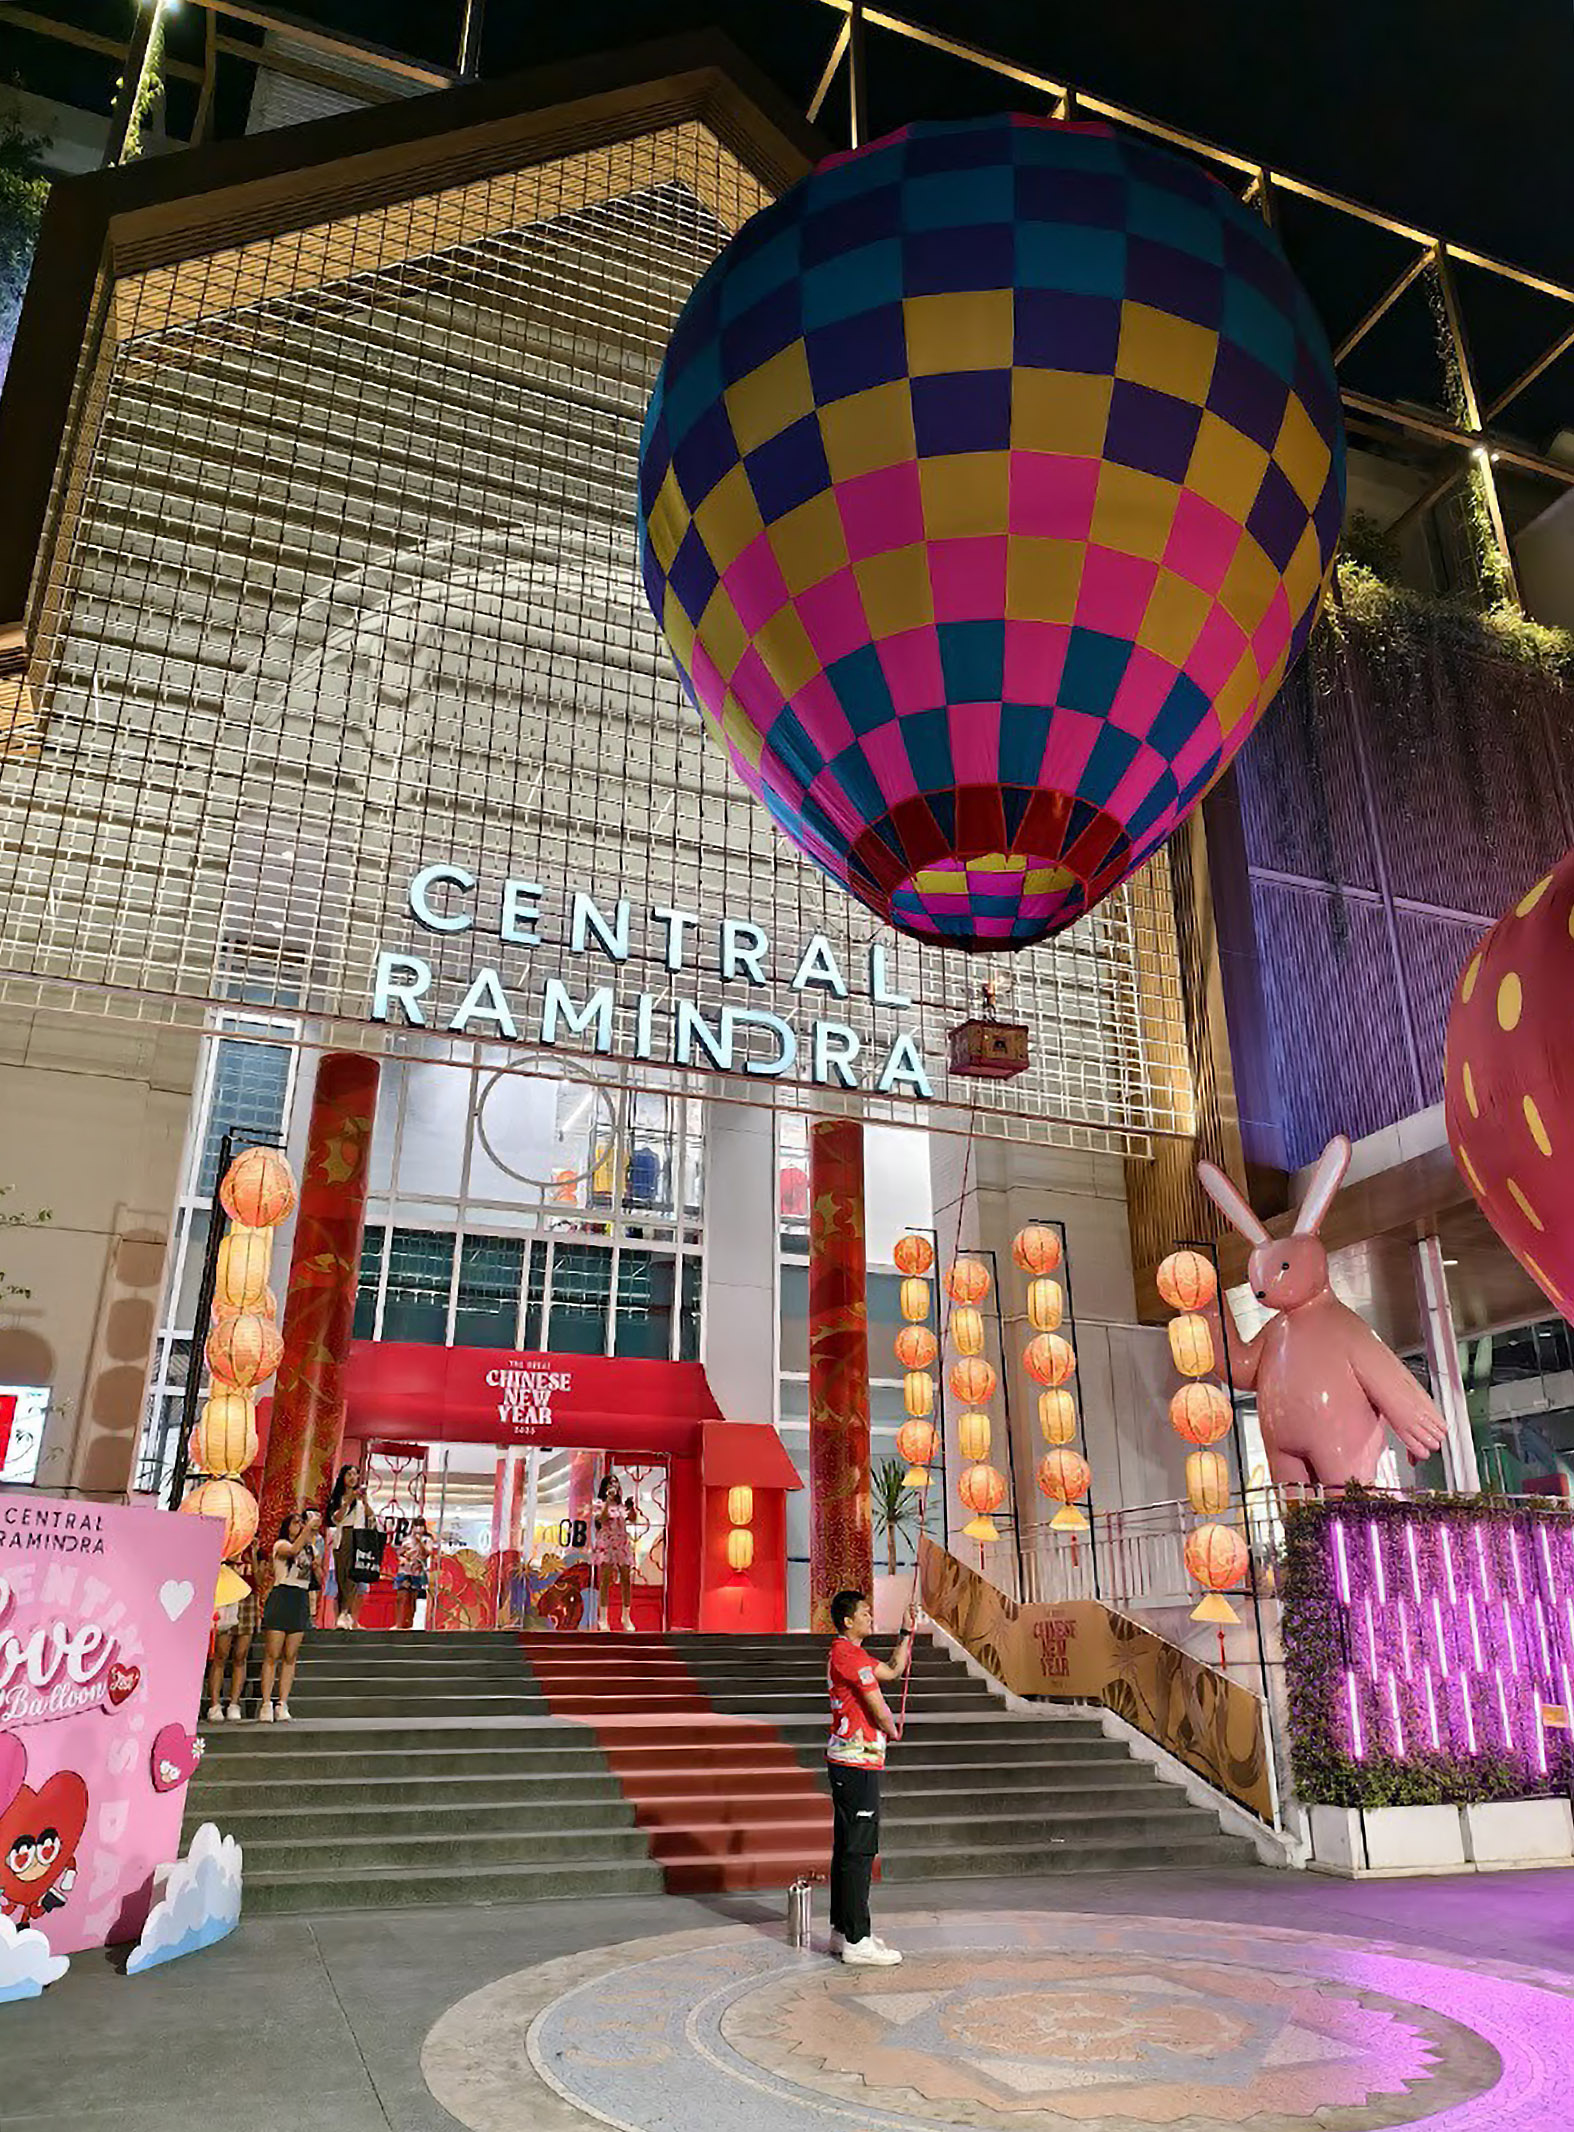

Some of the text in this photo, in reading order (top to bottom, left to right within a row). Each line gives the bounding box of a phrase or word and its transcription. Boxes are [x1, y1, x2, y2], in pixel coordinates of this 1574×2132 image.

[409, 863, 912, 1009] CENTRAL
[370, 951, 934, 1098] RAMINDRA
[486, 1369, 572, 1392] CHINESE
[503, 1388, 551, 1407] NEW
[497, 1405, 552, 1425] YEAR
[4, 1506, 103, 1532] CENTRAL
[0, 1577, 117, 1688] ove
[2, 1680, 108, 1722] Balloon
